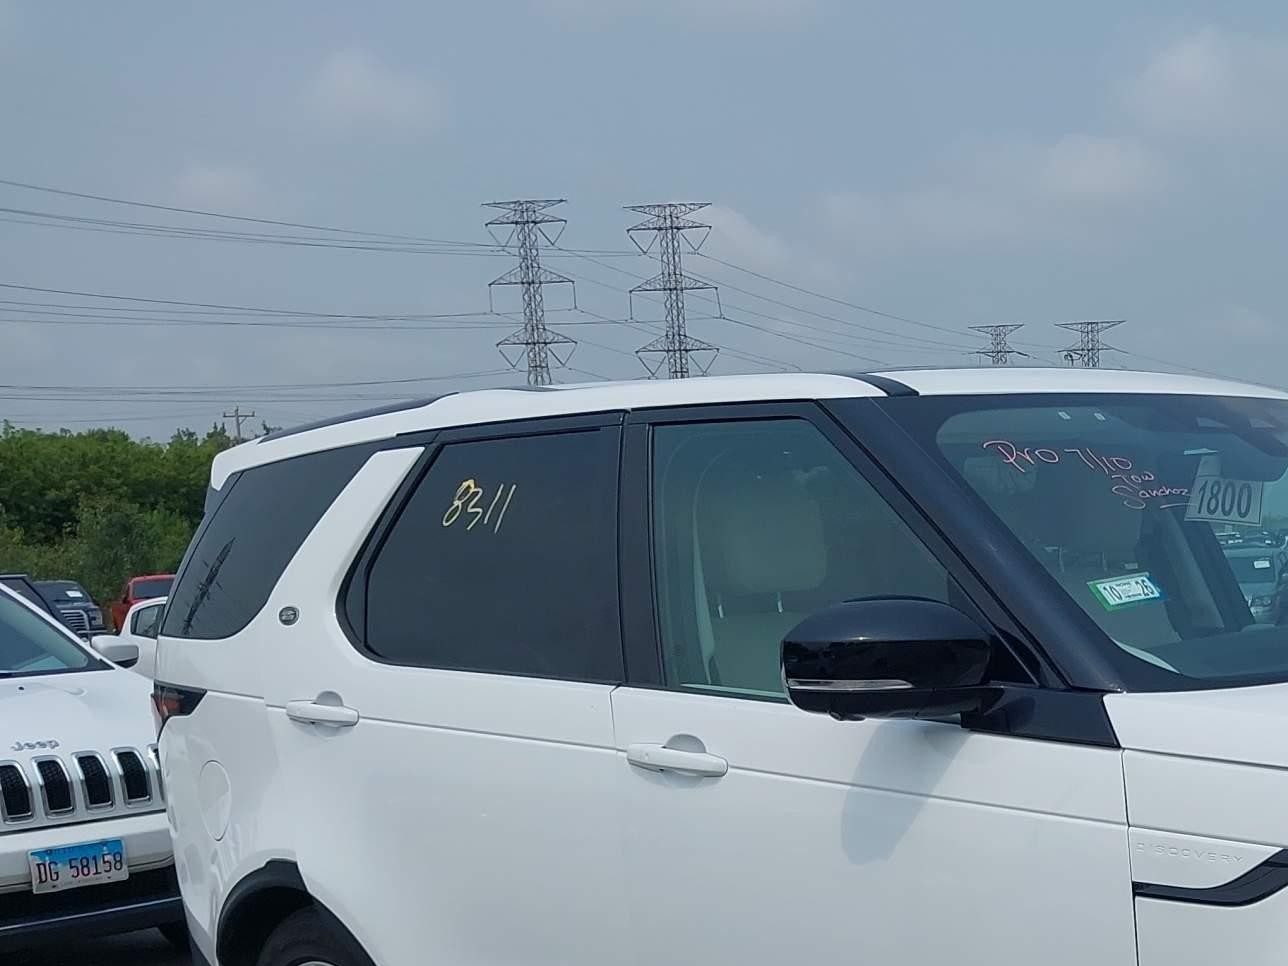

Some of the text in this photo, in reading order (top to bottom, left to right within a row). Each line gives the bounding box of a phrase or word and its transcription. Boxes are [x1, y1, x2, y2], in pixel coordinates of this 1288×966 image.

[983, 440, 1060, 473] Pro
[1111, 471, 1155, 491] Tow
[443, 479, 516, 533] 8311
[1196, 480, 1253, 519] 1800
[11, 739, 60, 751] Jeep
[36, 851, 123, 884] DG 58158
[1135, 842, 1246, 866] DSCOVERY
